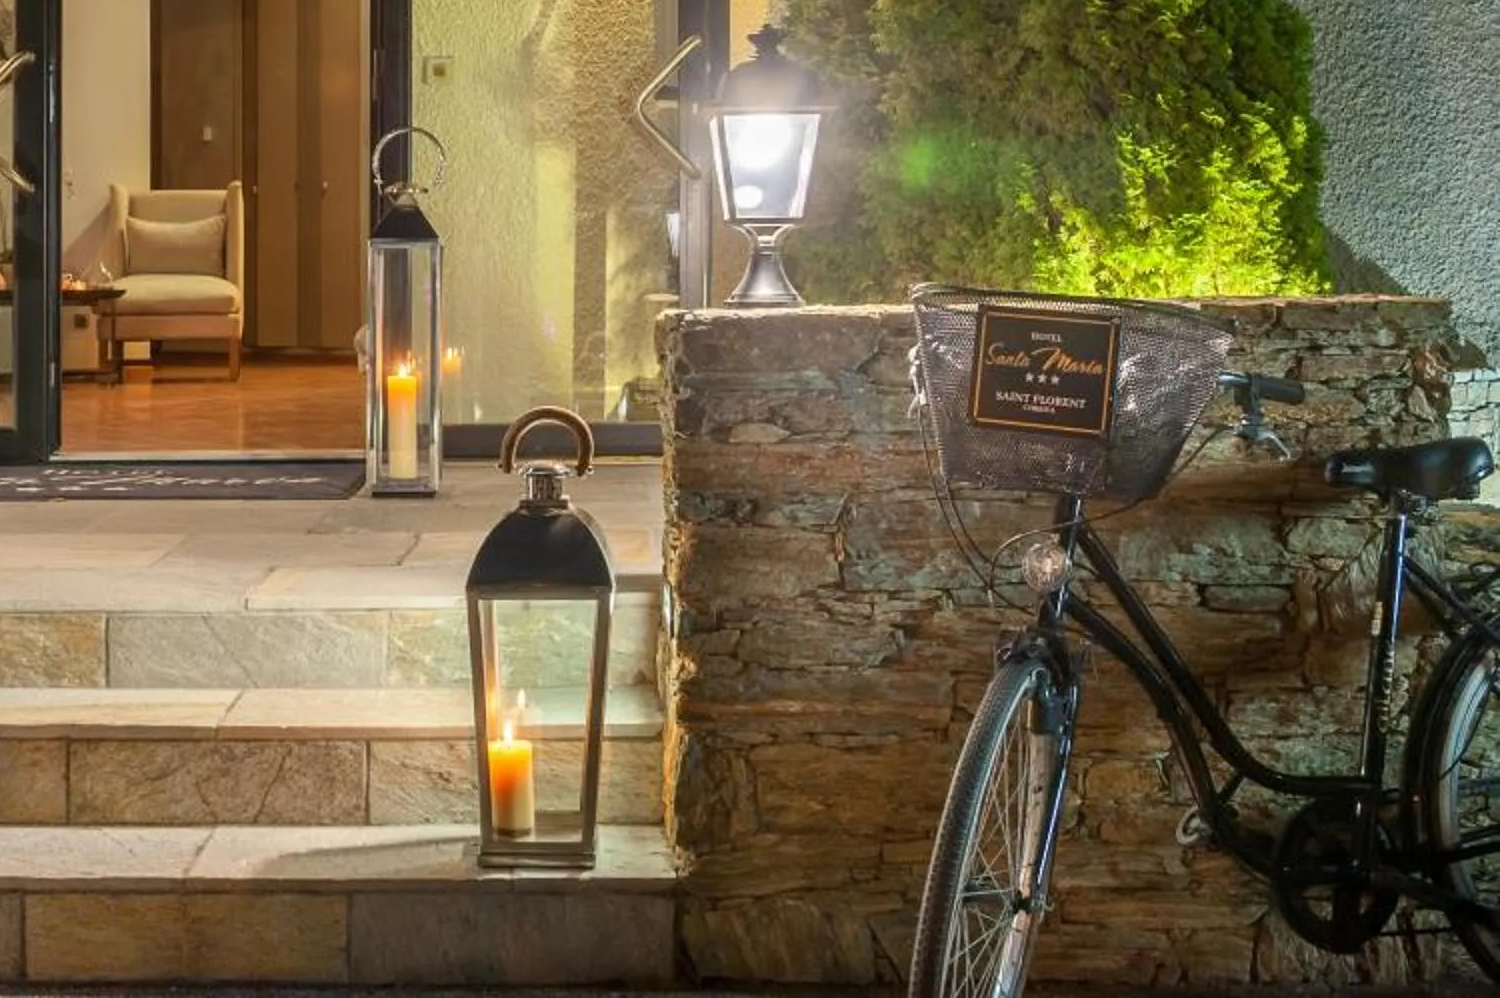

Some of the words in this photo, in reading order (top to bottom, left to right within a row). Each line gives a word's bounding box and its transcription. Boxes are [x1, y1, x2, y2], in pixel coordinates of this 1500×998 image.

[986, 343, 1031, 367] Santa
[1031, 346, 1103, 375] Maria
[995, 390, 1031, 403] SAINT
